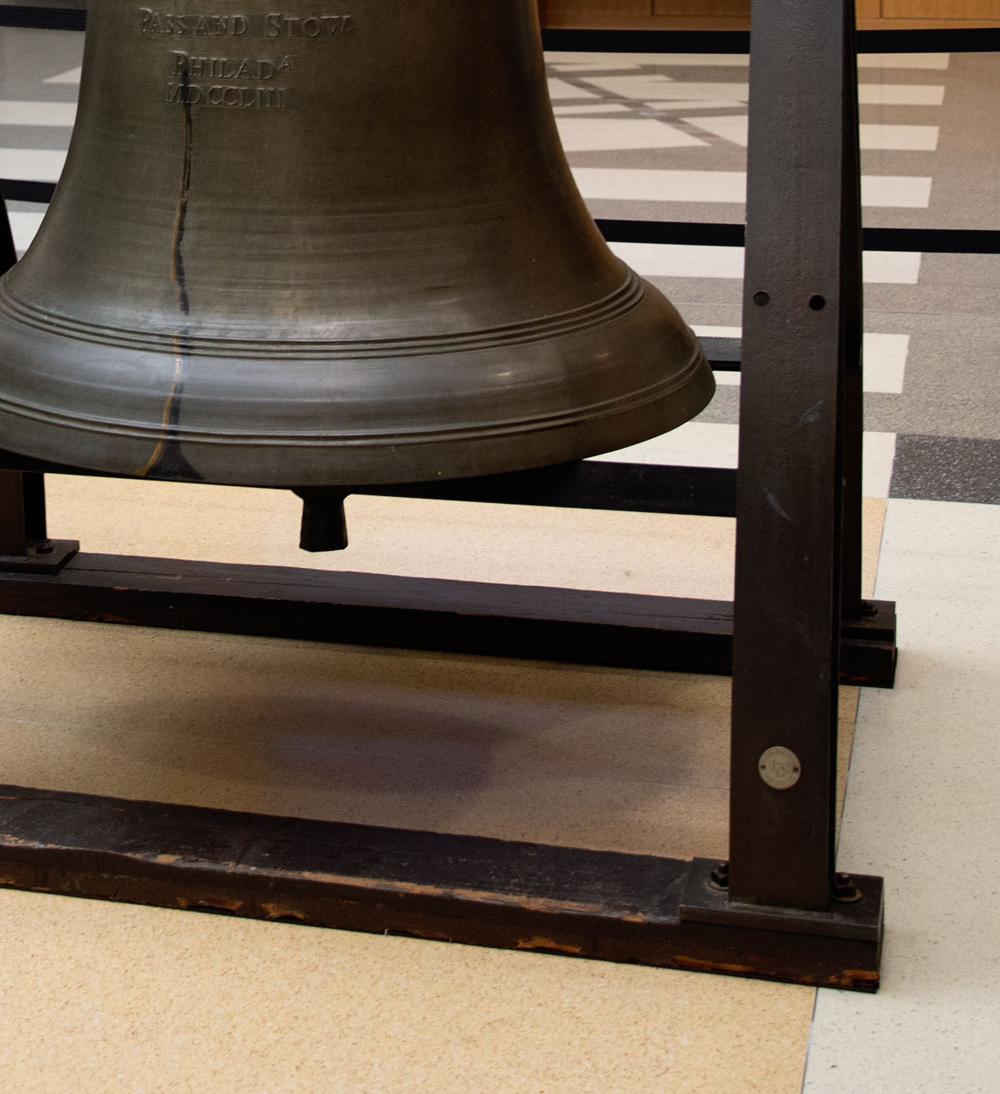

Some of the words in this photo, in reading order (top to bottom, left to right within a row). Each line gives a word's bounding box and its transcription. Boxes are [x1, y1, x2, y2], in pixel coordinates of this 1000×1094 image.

[139, 7, 187, 36] PASS
[194, 13, 250, 38] AND
[264, 12, 353, 38] STOW
